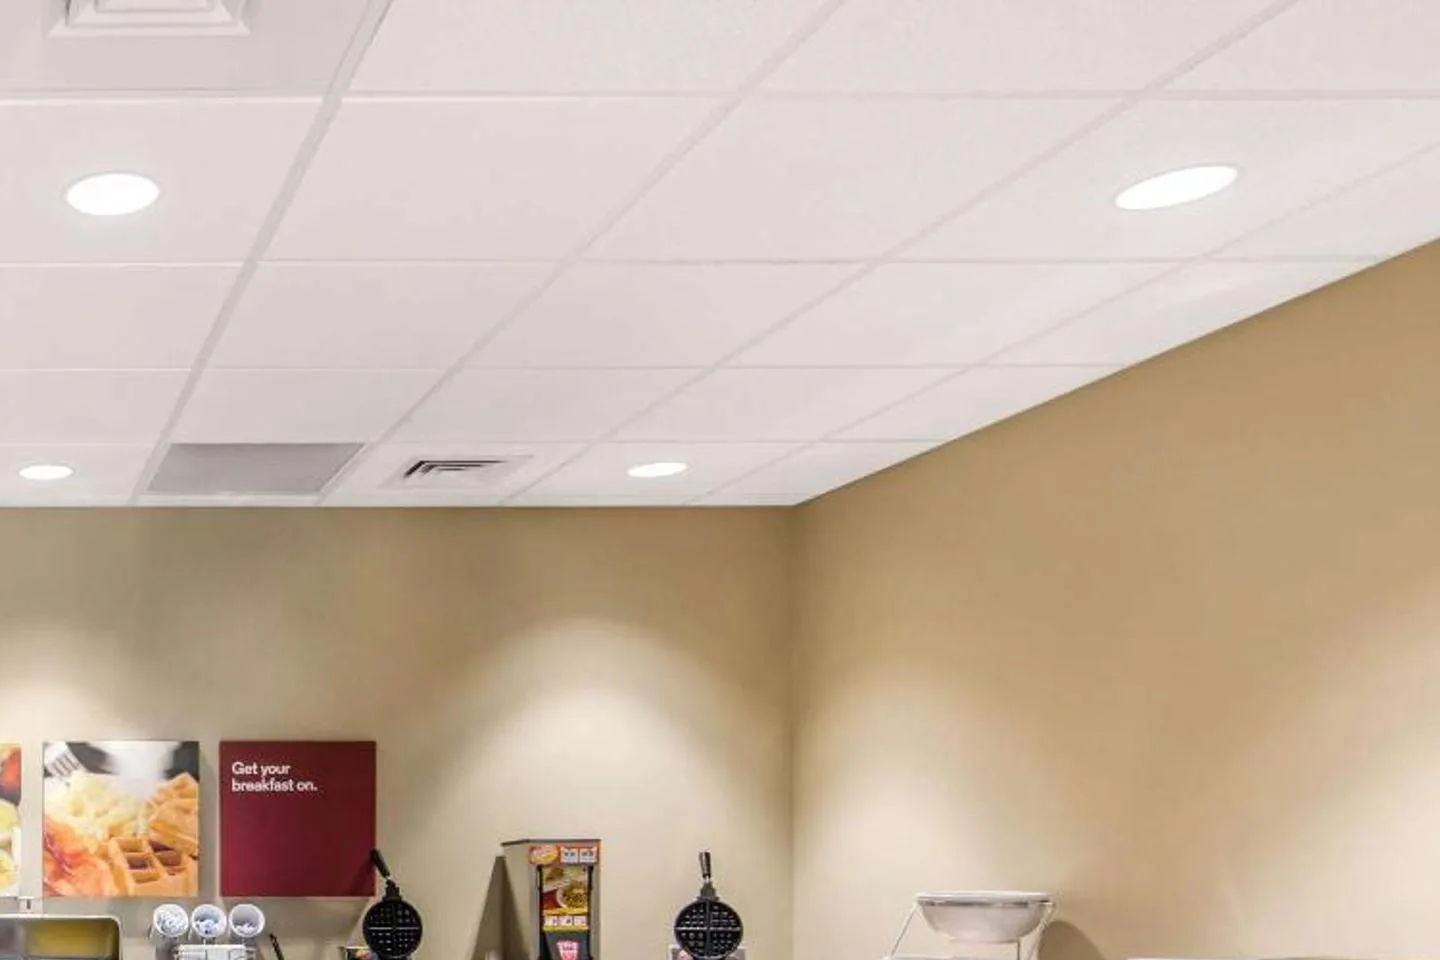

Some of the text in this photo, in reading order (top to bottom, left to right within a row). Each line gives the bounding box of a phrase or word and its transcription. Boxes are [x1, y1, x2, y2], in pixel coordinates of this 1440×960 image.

[231, 761, 291, 778] Get your
[231, 777, 318, 792] breakfast on.
